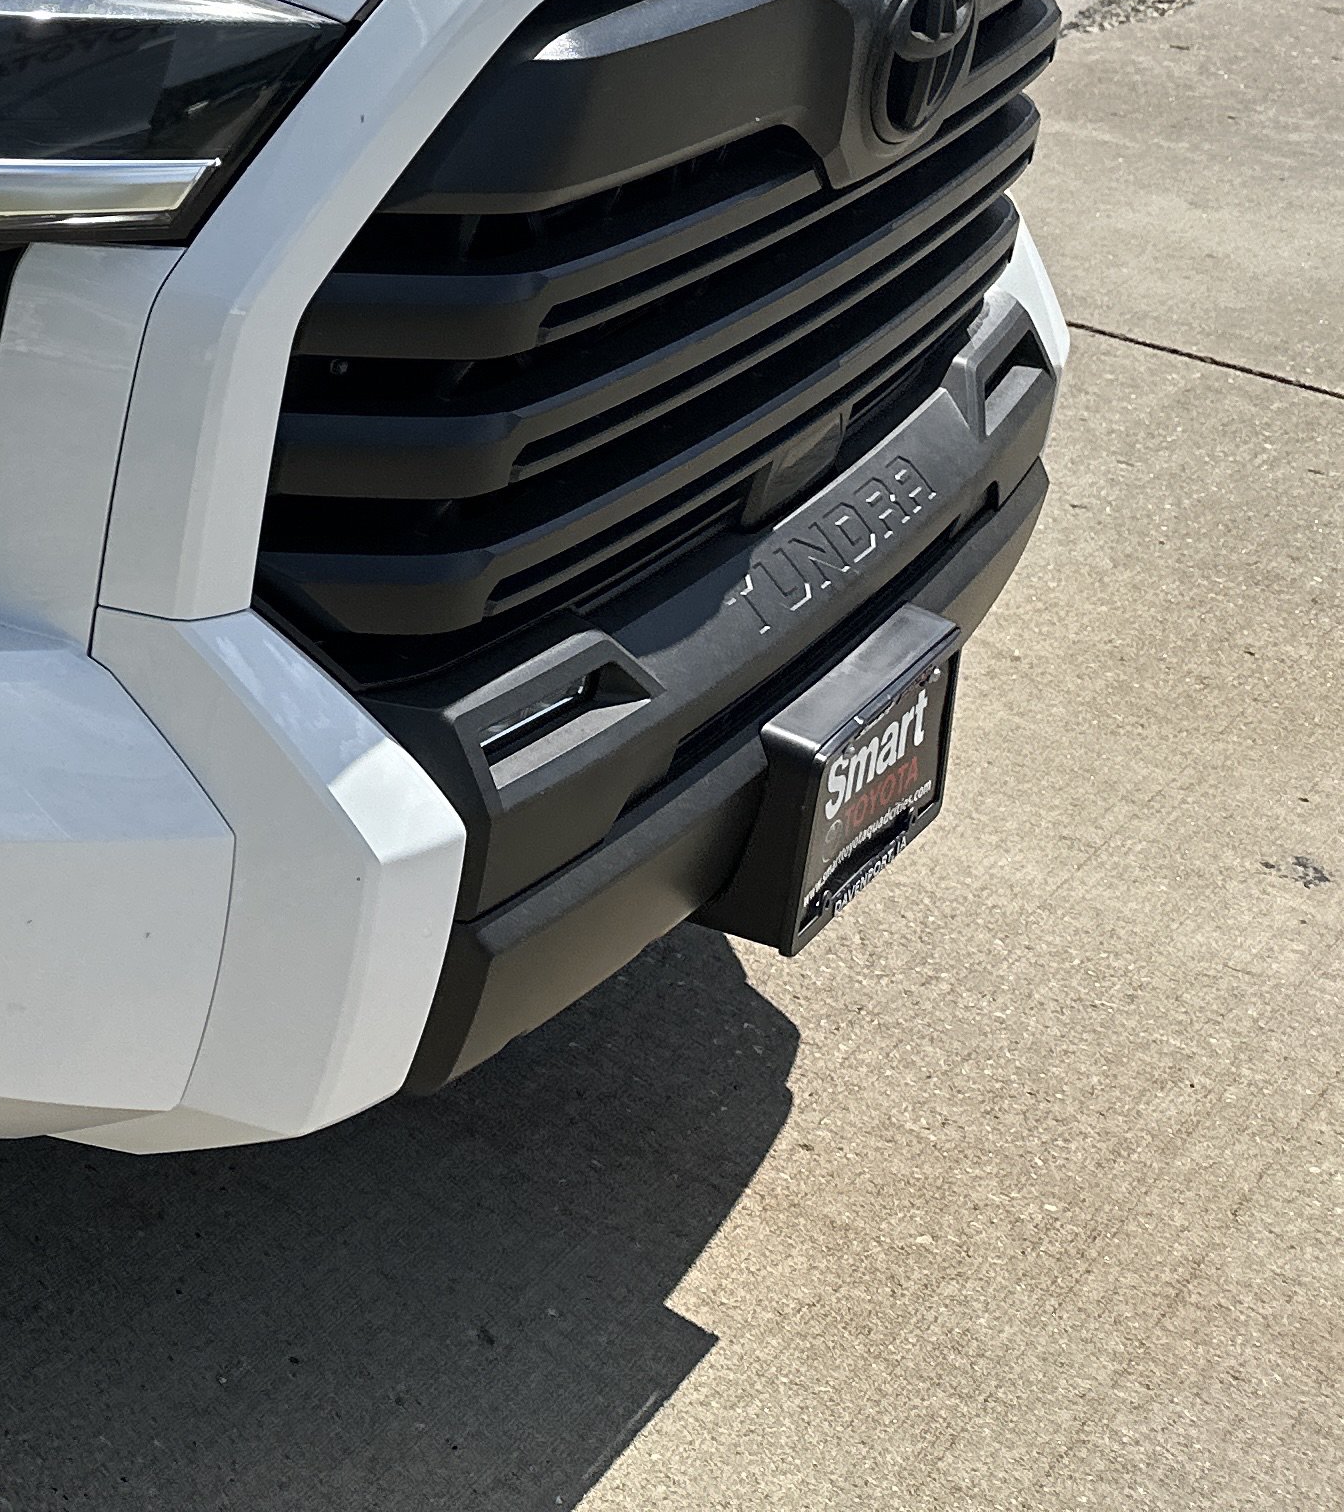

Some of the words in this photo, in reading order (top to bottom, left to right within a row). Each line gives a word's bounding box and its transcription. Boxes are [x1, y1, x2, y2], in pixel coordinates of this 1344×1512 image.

[722, 454, 938, 634] TUNDRA
[824, 688, 929, 820] Smart
[844, 755, 920, 838] TOYOTA
